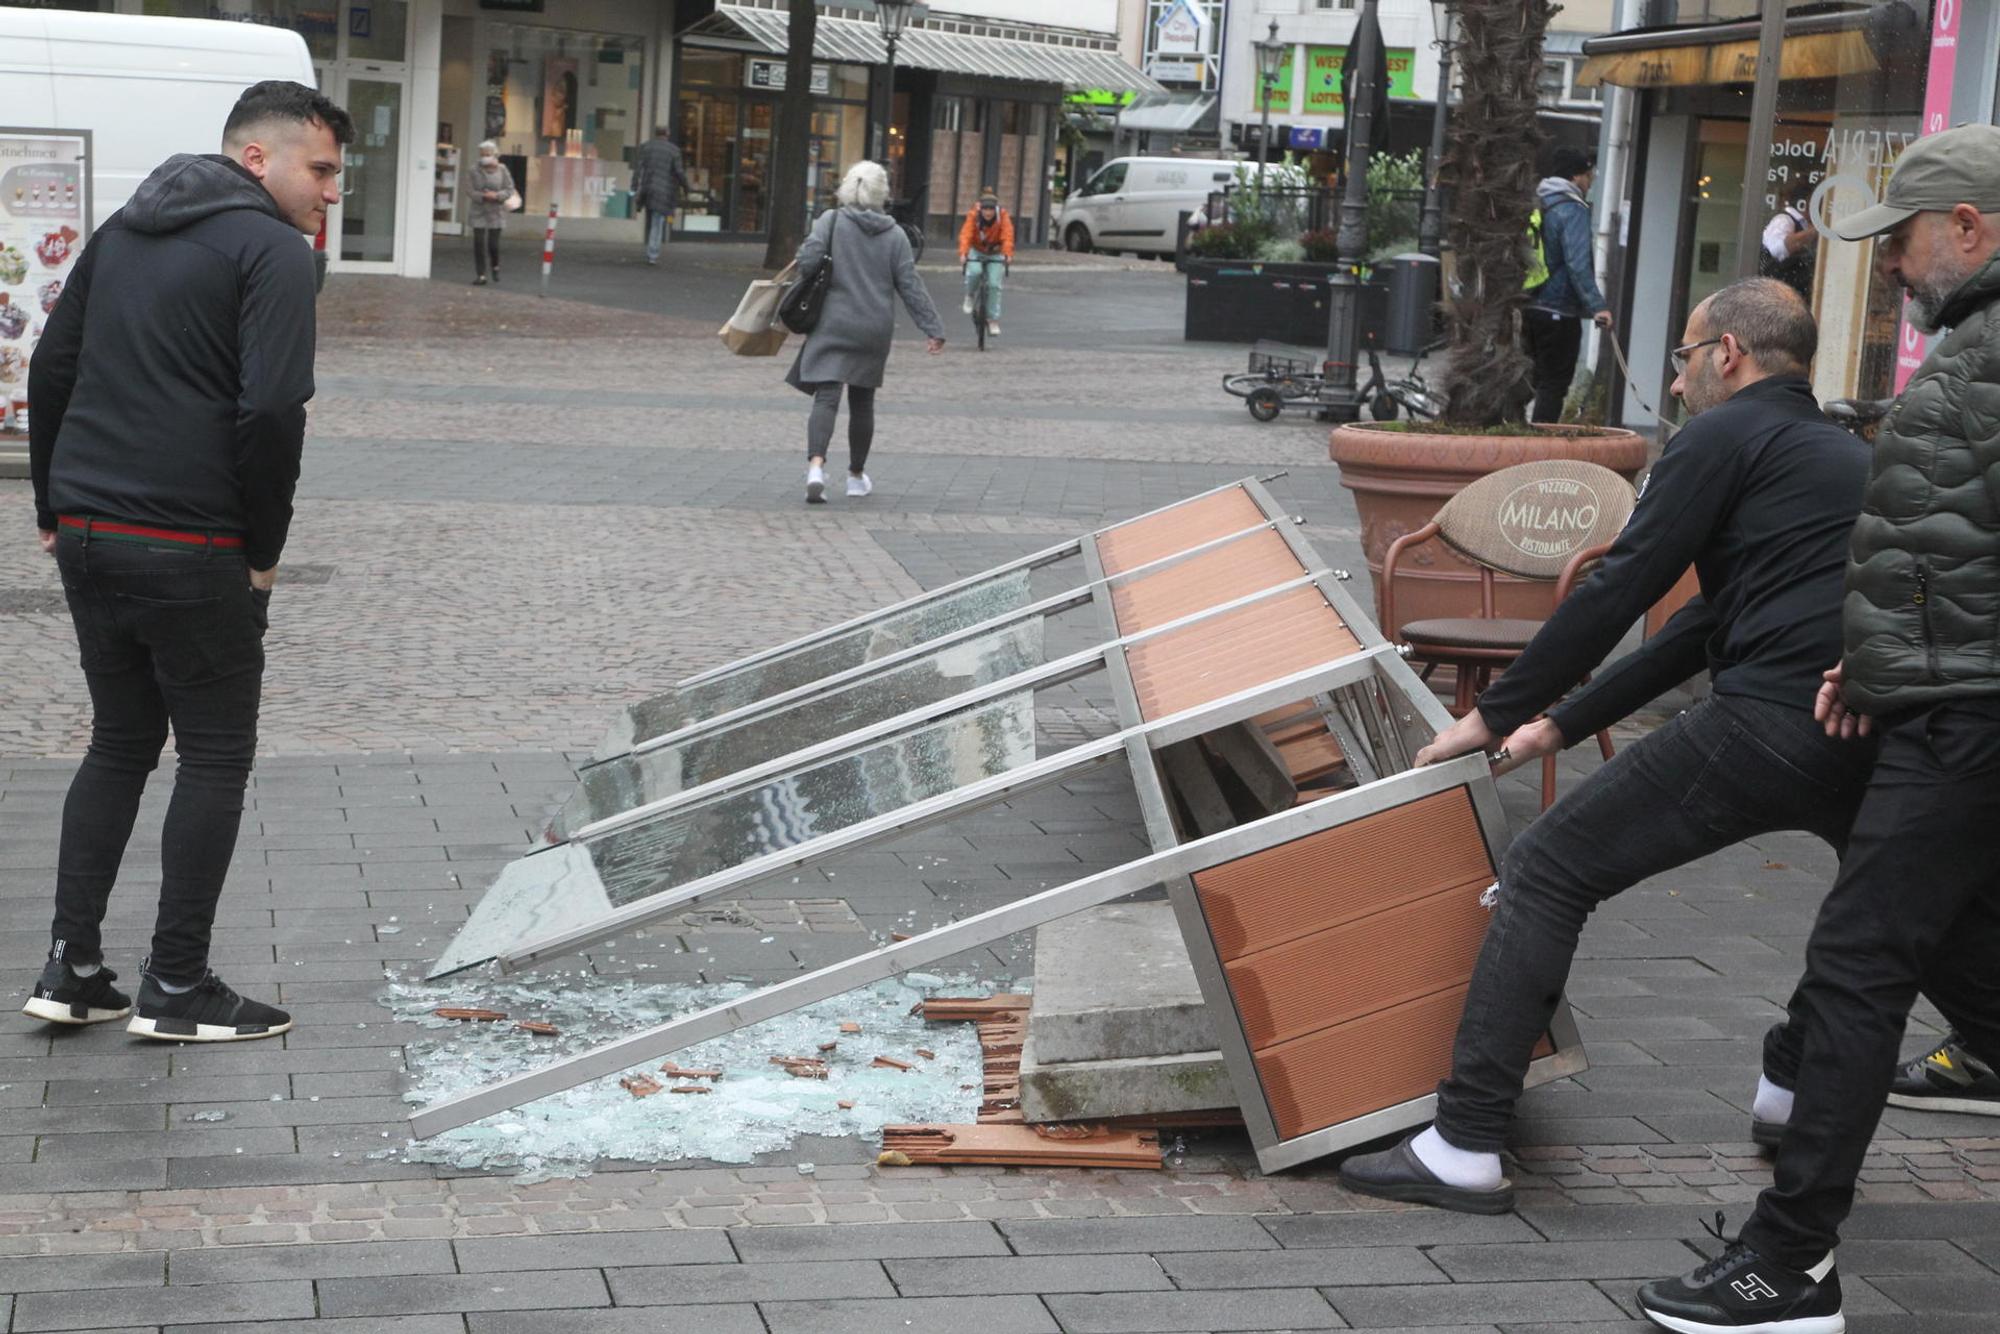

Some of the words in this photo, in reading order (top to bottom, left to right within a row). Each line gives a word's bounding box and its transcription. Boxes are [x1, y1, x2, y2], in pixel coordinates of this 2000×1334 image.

[1386, 58, 1409, 72] EST
[1539, 481, 1580, 496] PIZZERIA
[1502, 500, 1597, 531] MILANO
[1519, 536, 1570, 554] RISTORANTE
